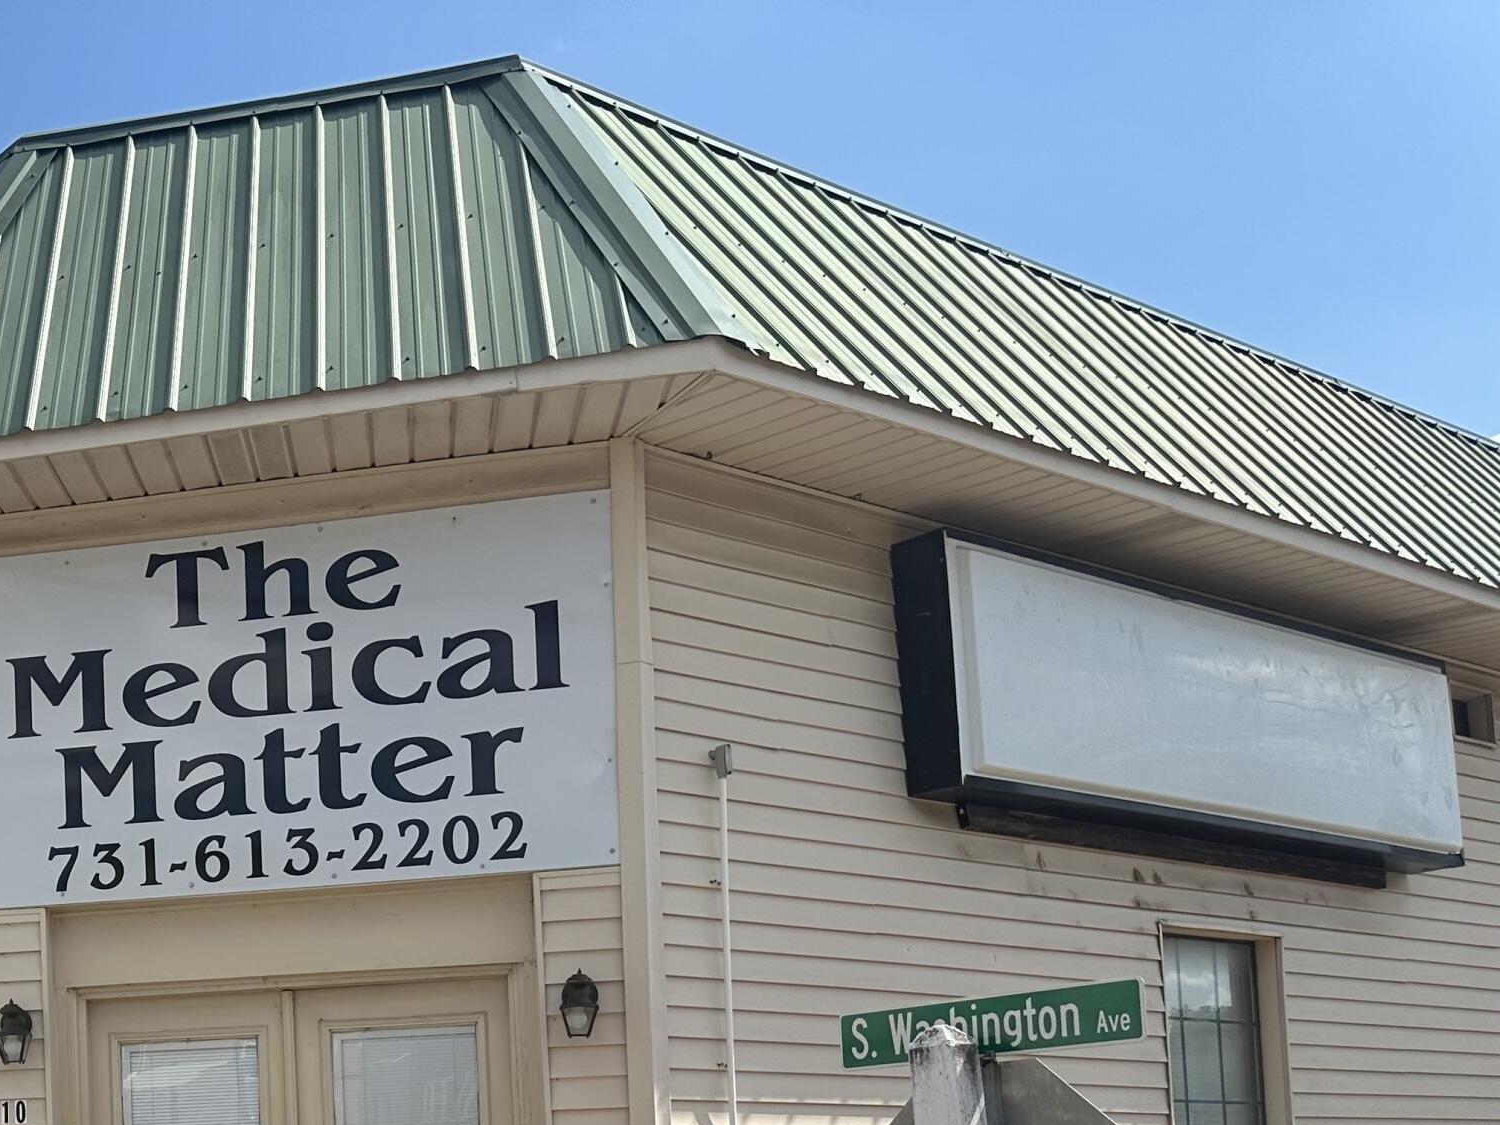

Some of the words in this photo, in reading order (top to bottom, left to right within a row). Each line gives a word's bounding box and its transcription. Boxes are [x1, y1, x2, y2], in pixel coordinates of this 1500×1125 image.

[144, 540, 402, 629] The
[5, 600, 571, 740] Medical
[55, 722, 525, 831] Matter
[47, 811, 528, 892] 731-613-2202
[850, 1017, 878, 1060] S.
[888, 997, 1081, 1055] Whington
[1096, 1010, 1132, 1034] Ave
